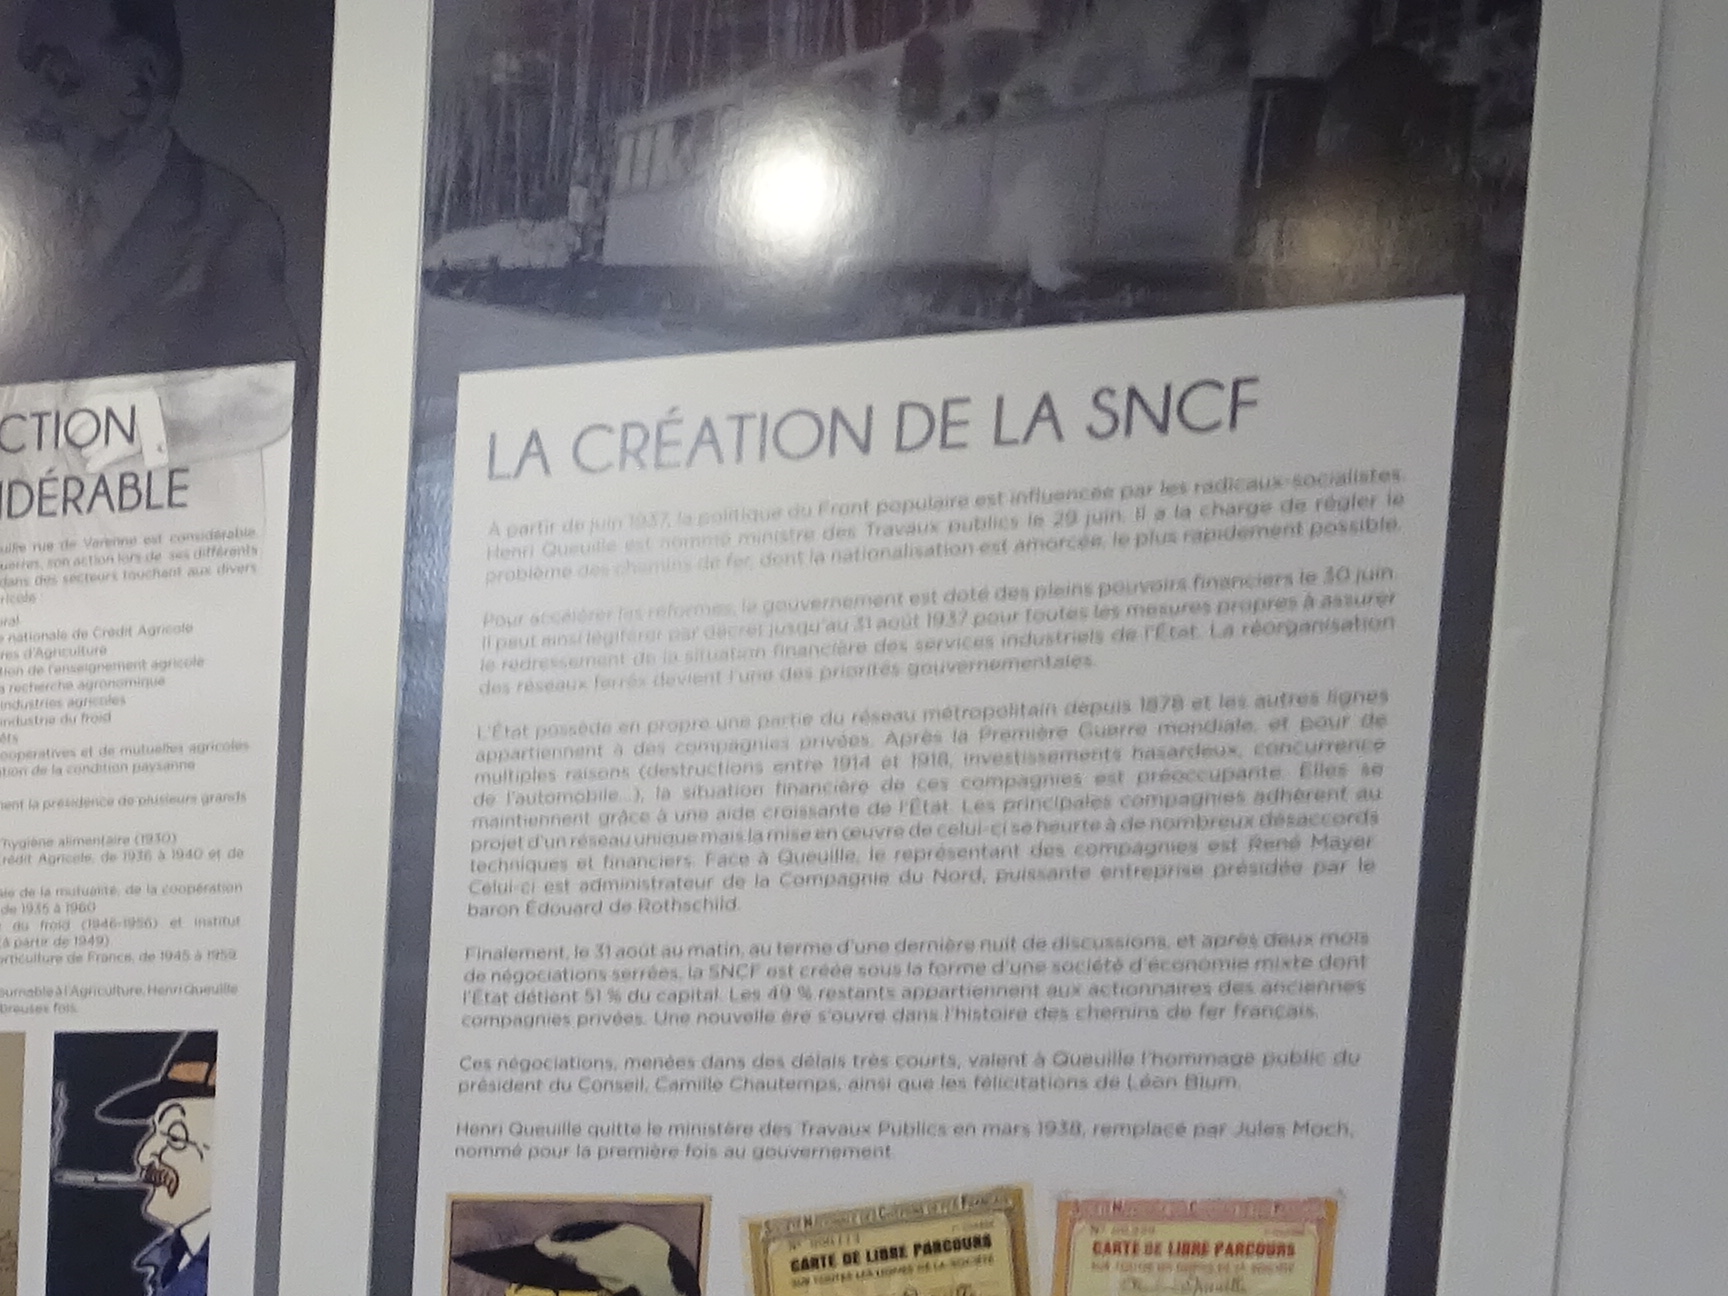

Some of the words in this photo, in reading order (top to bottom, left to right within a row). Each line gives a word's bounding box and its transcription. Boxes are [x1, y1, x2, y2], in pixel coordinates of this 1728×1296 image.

[487, 429, 550, 481] LA
[571, 404, 874, 475] CRÉATION
[894, 396, 970, 453] DE
[992, 391, 1064, 446] LA
[1086, 376, 1260, 442] SNCF
[466, 900, 519, 917] baron
[525, 898, 603, 916] Édouard
[608, 898, 632, 914] de
[457, 1076, 542, 1095] président
[548, 1076, 572, 1091] du
[654, 1075, 723, 1091] Camille
[847, 1074, 891, 1090] ainsi
[897, 1077, 934, 1094] que
[940, 1073, 967, 1090] les
[973, 1073, 1088, 1089] félicitations
[1094, 1073, 1120, 1089] de
[455, 1121, 503, 1136] Henri
[507, 1120, 582, 1140] Queuille
[587, 1120, 641, 1140] quitte
[646, 1120, 662, 1136] le
[667, 1120, 754, 1136] ministère
[758, 1120, 792, 1136] des
[801, 1120, 871, 1136] Travaux
[877, 1120, 947, 1136] Publics
[952, 1123, 976, 1136] en
[981, 1123, 1031, 1136] mars
[1092, 1120, 1187, 1140] remplacé
[1192, 1123, 1226, 1140] par
[1236, 1119, 1286, 1136] Jules
[1291, 1119, 1353, 1140] Moch,
[454, 1142, 522, 1158] nommé
[527, 1146, 568, 1162] pour
[575, 1142, 591, 1158] la
[596, 1142, 679, 1162] première
[684, 1142, 717, 1158] fois
[723, 1146, 745, 1158] au
[790, 1253, 837, 1272] CARTE
[842, 1250, 861, 1266] DE
[866, 1243, 906, 1262] LIBRE
[913, 1233, 992, 1255] PARCOURS
[1092, 1240, 1140, 1256] CARTE
[1144, 1241, 1162, 1256] DE
[1168, 1241, 1209, 1256] LIBRE
[1214, 1241, 1296, 1257] PARCOURS
